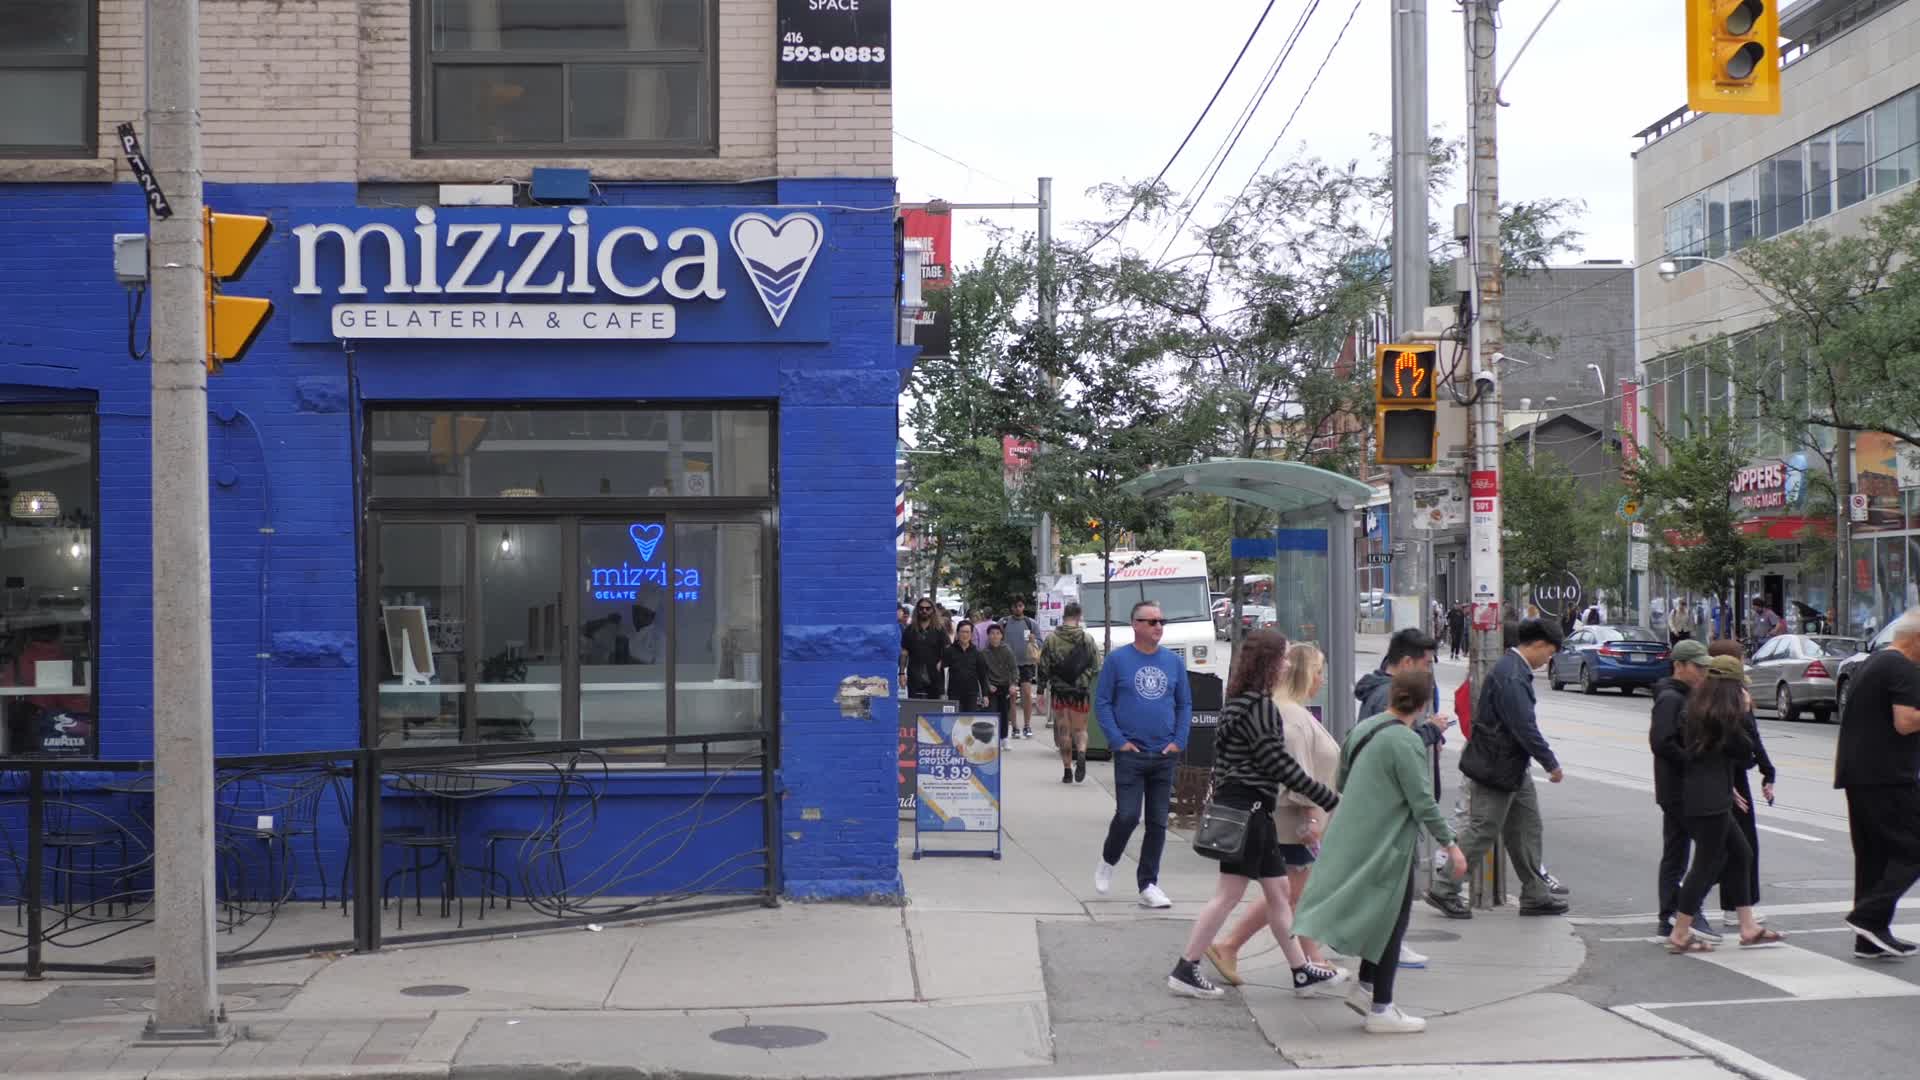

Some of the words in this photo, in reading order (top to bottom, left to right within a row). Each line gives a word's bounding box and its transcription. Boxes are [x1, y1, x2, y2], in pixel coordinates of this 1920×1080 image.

[809, 0, 859, 10] SPACE
[784, 32, 804, 43] 416
[782, 46, 886, 62] 593-0883
[293, 205, 726, 299] mizzica
[340, 310, 524, 328] GELATERIA
[546, 310, 561, 329] &
[583, 311, 665, 329] CAFE
[1730, 464, 1783, 492] OPPERS
[1761, 492, 1783, 507] MART
[676, 592, 697, 600] AFE
[930, 765, 972, 781] $3.99
